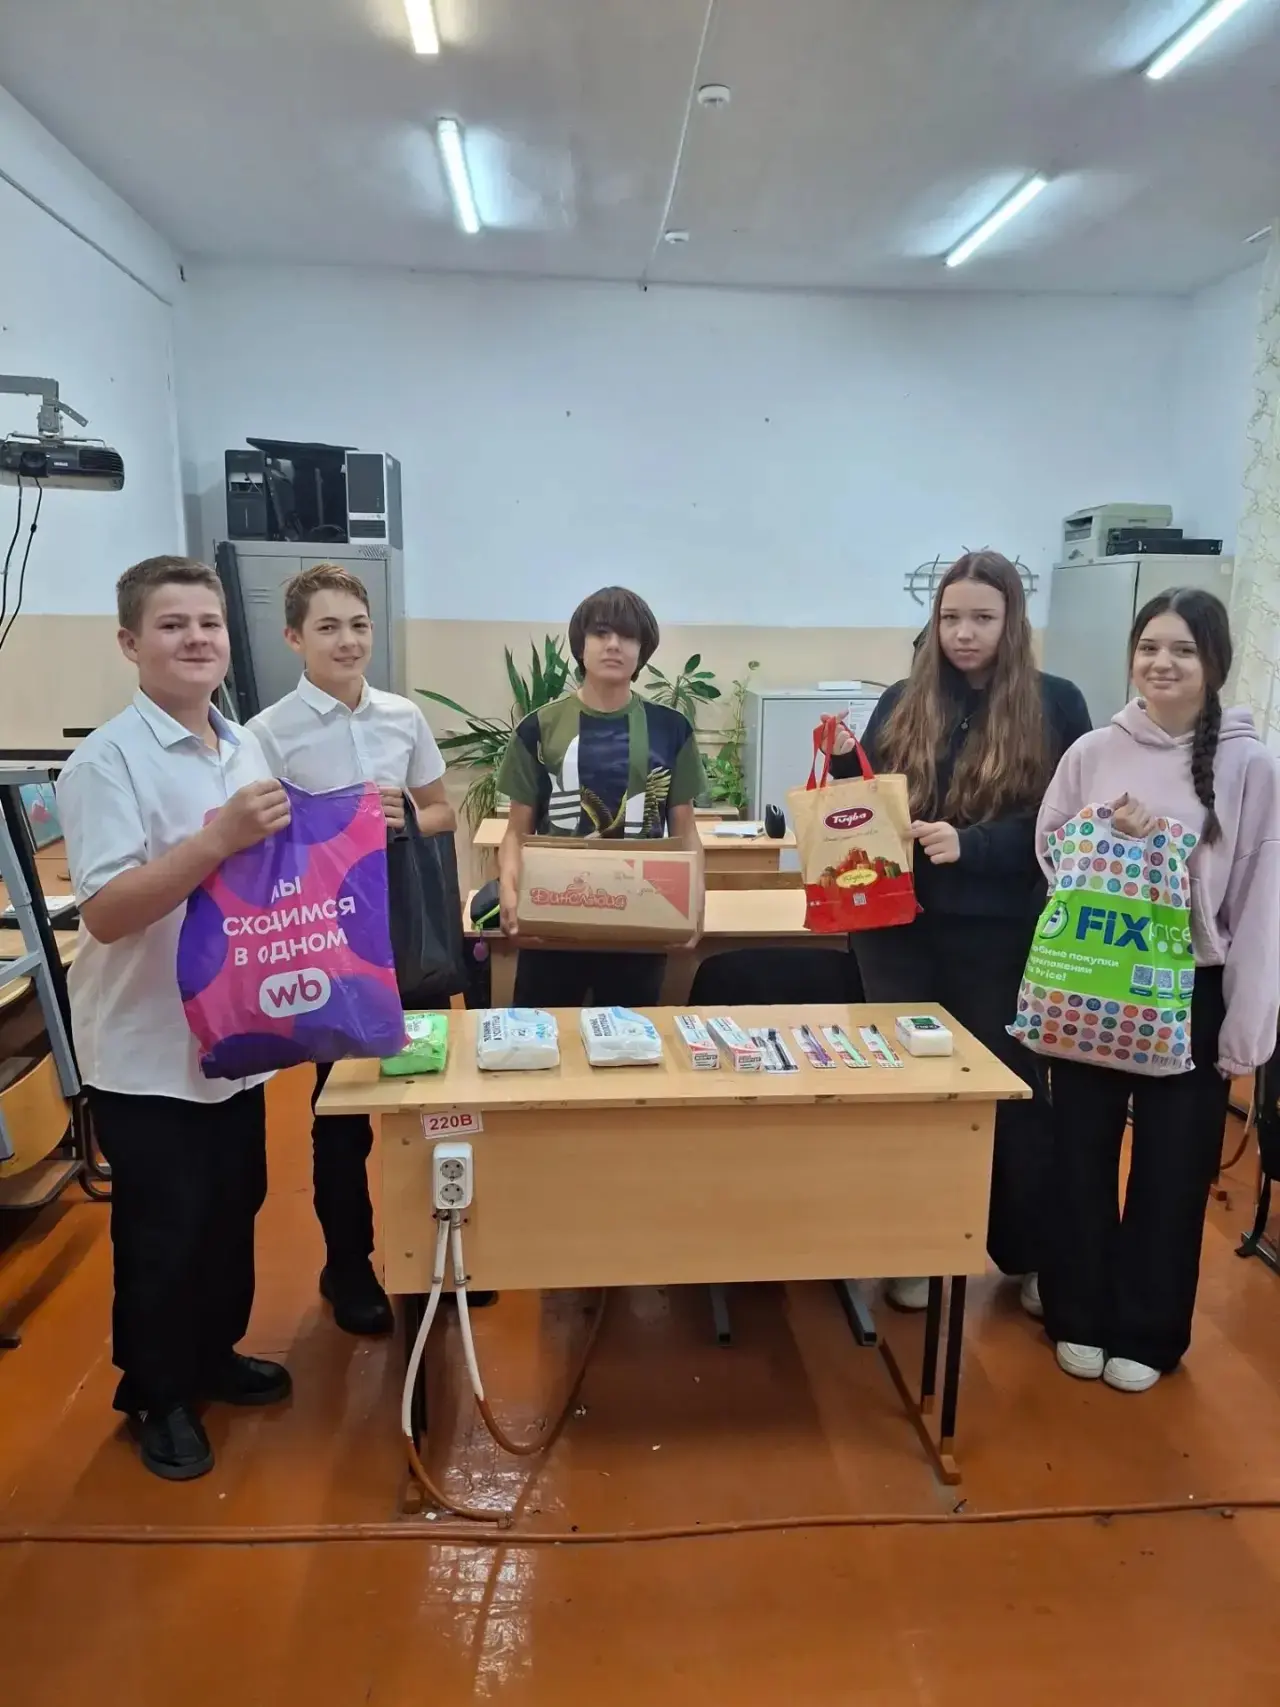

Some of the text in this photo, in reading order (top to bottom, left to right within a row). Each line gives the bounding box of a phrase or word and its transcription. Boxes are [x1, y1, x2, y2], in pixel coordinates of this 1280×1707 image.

[234, 928, 348, 966] В ОДНОМ
[1068, 952, 1120, 968] покупки
[266, 973, 323, 1008] wb
[429, 1113, 473, 1131] 220В
